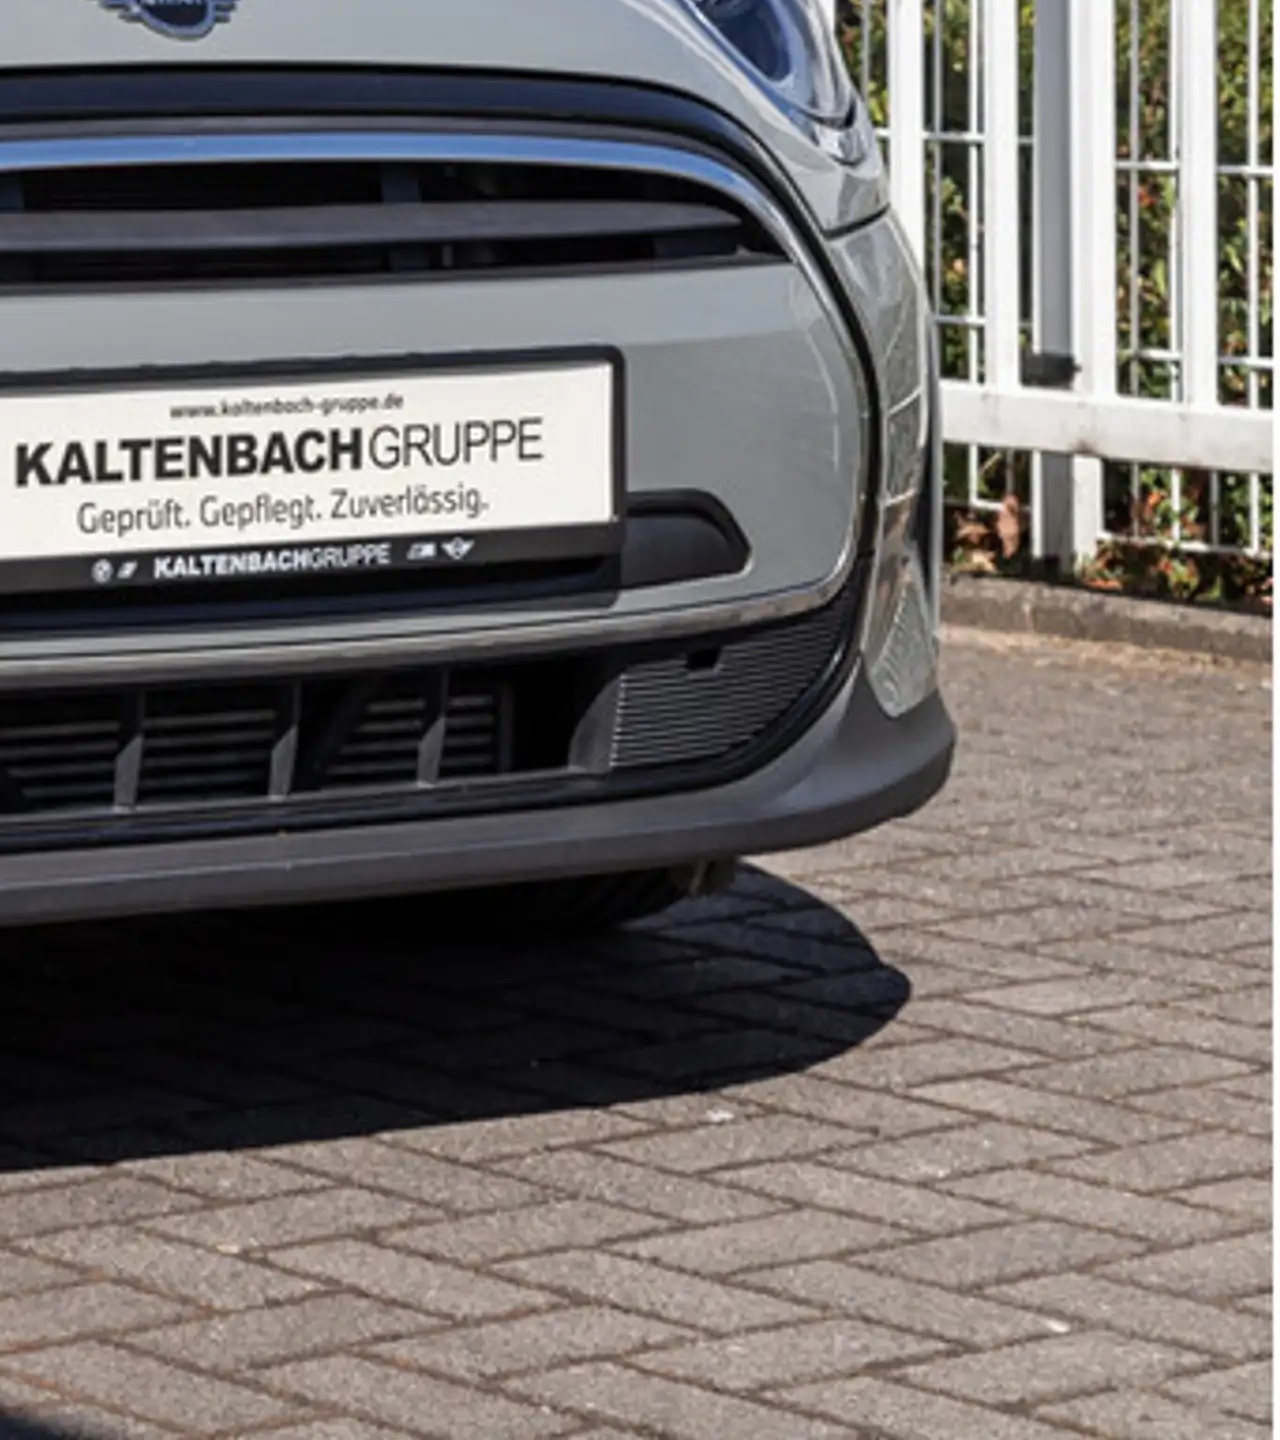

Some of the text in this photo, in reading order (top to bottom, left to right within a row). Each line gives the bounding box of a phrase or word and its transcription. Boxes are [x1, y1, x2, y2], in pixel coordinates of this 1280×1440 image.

[169, 392, 405, 420] www.kaltenbach-gruppe.de
[14, 416, 545, 488] KALTENBACHGRUPPE
[77, 482, 490, 537] Geprüft. Gepflegt. Zuverlässig.
[153, 542, 392, 580] KALTENBACHGRUPPE
